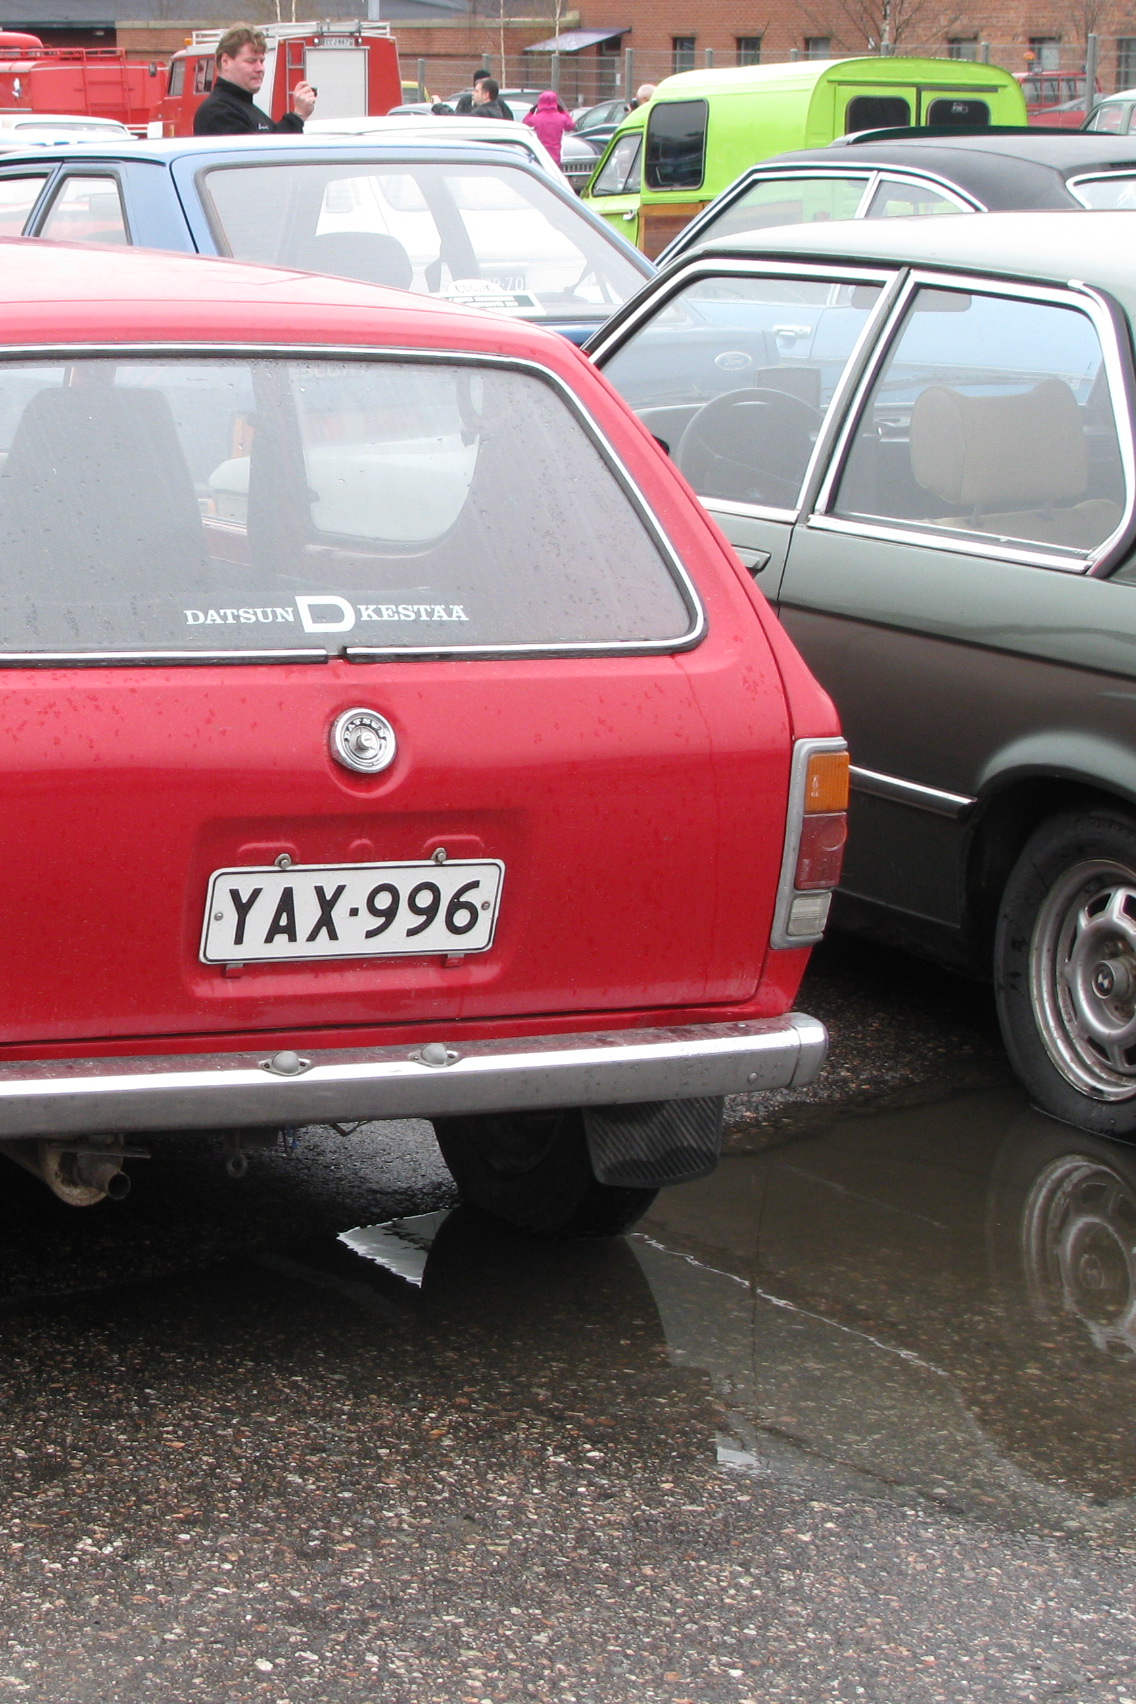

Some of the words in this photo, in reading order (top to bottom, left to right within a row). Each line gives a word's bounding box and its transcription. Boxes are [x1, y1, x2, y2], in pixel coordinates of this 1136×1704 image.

[184, 607, 295, 625] DATSUN
[357, 604, 469, 621] KESTÄÄ
[229, 880, 481, 945] YAX-996
